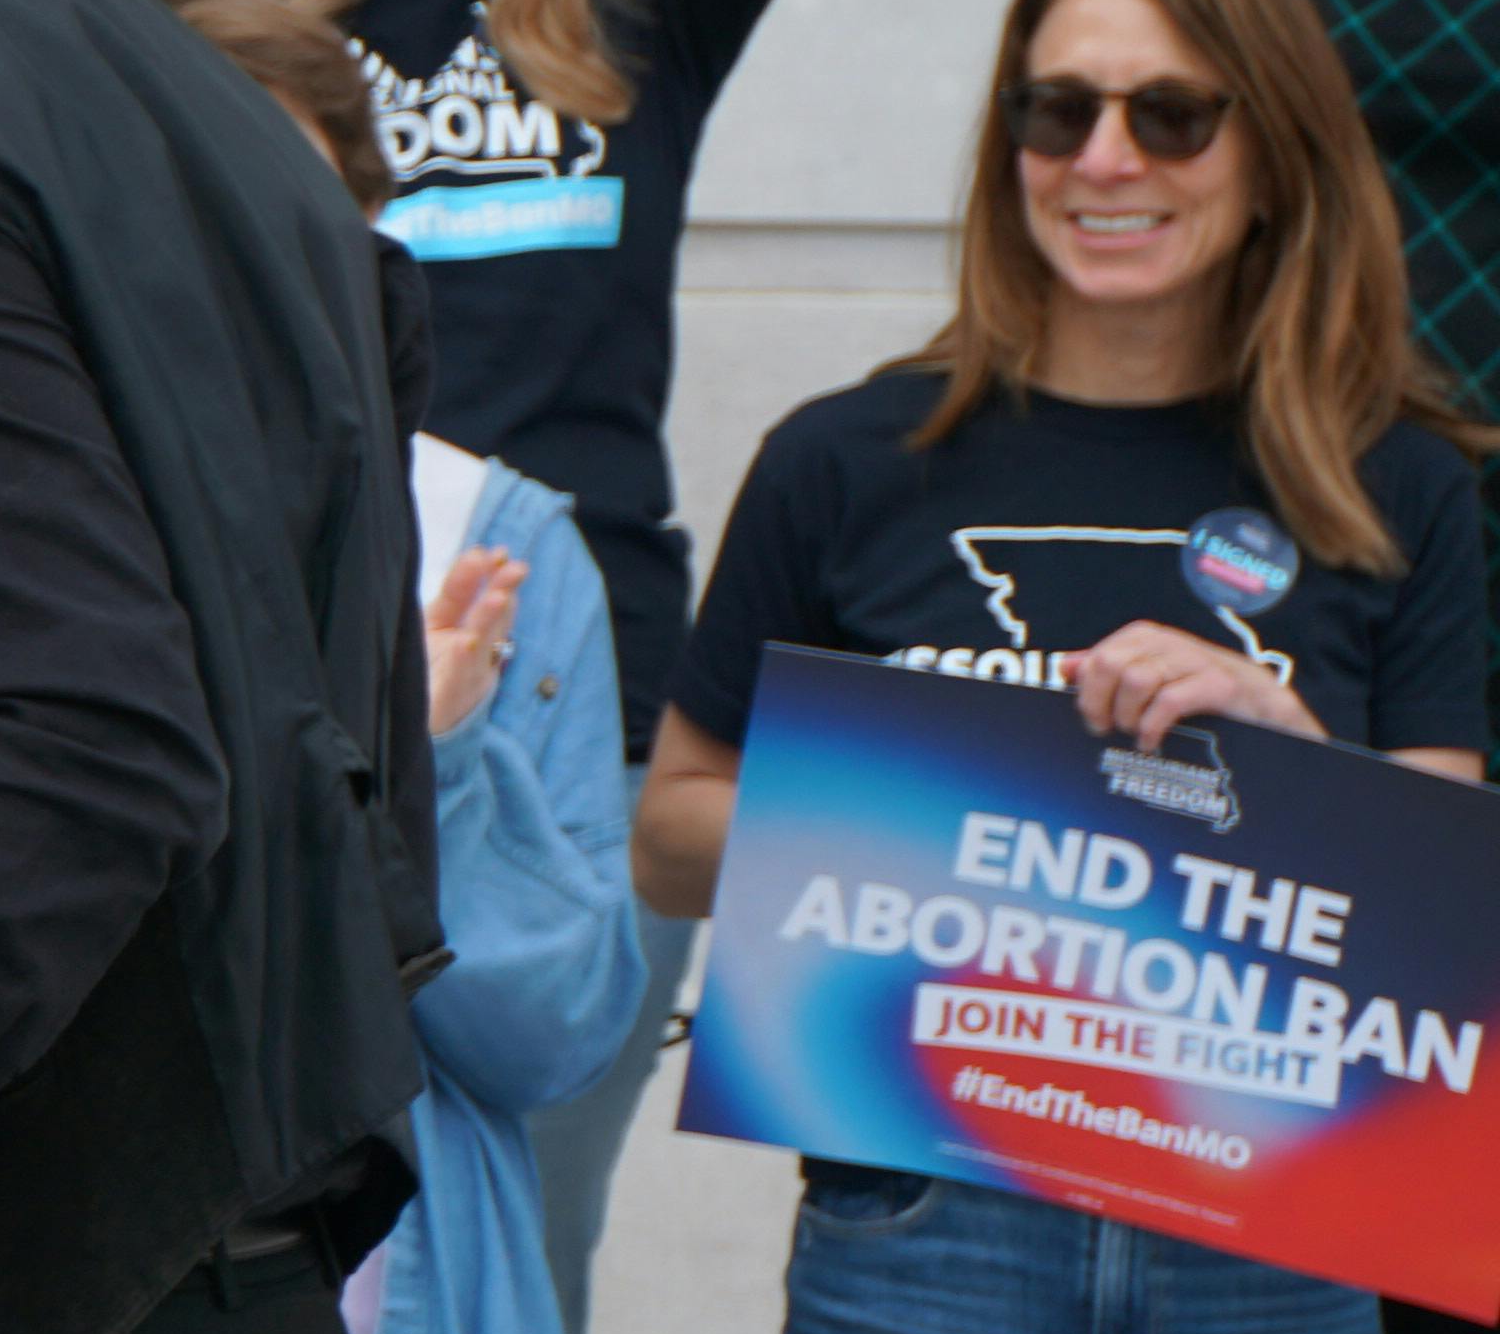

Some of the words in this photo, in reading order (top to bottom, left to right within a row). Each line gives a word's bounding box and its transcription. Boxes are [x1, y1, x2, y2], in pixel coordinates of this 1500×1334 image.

[1109, 771, 1230, 820] FREEDOM
[954, 810, 1153, 909] END
[1173, 852, 1353, 968] THE
[778, 873, 1268, 1039] ABORTION
[1283, 975, 1484, 1095] BAN
[933, 996, 1046, 1043] JOIN
[1064, 1012, 1158, 1062] THE
[1175, 1031, 1321, 1088] FIGHT
[950, 1064, 1253, 1170] #EndTheBanMO
